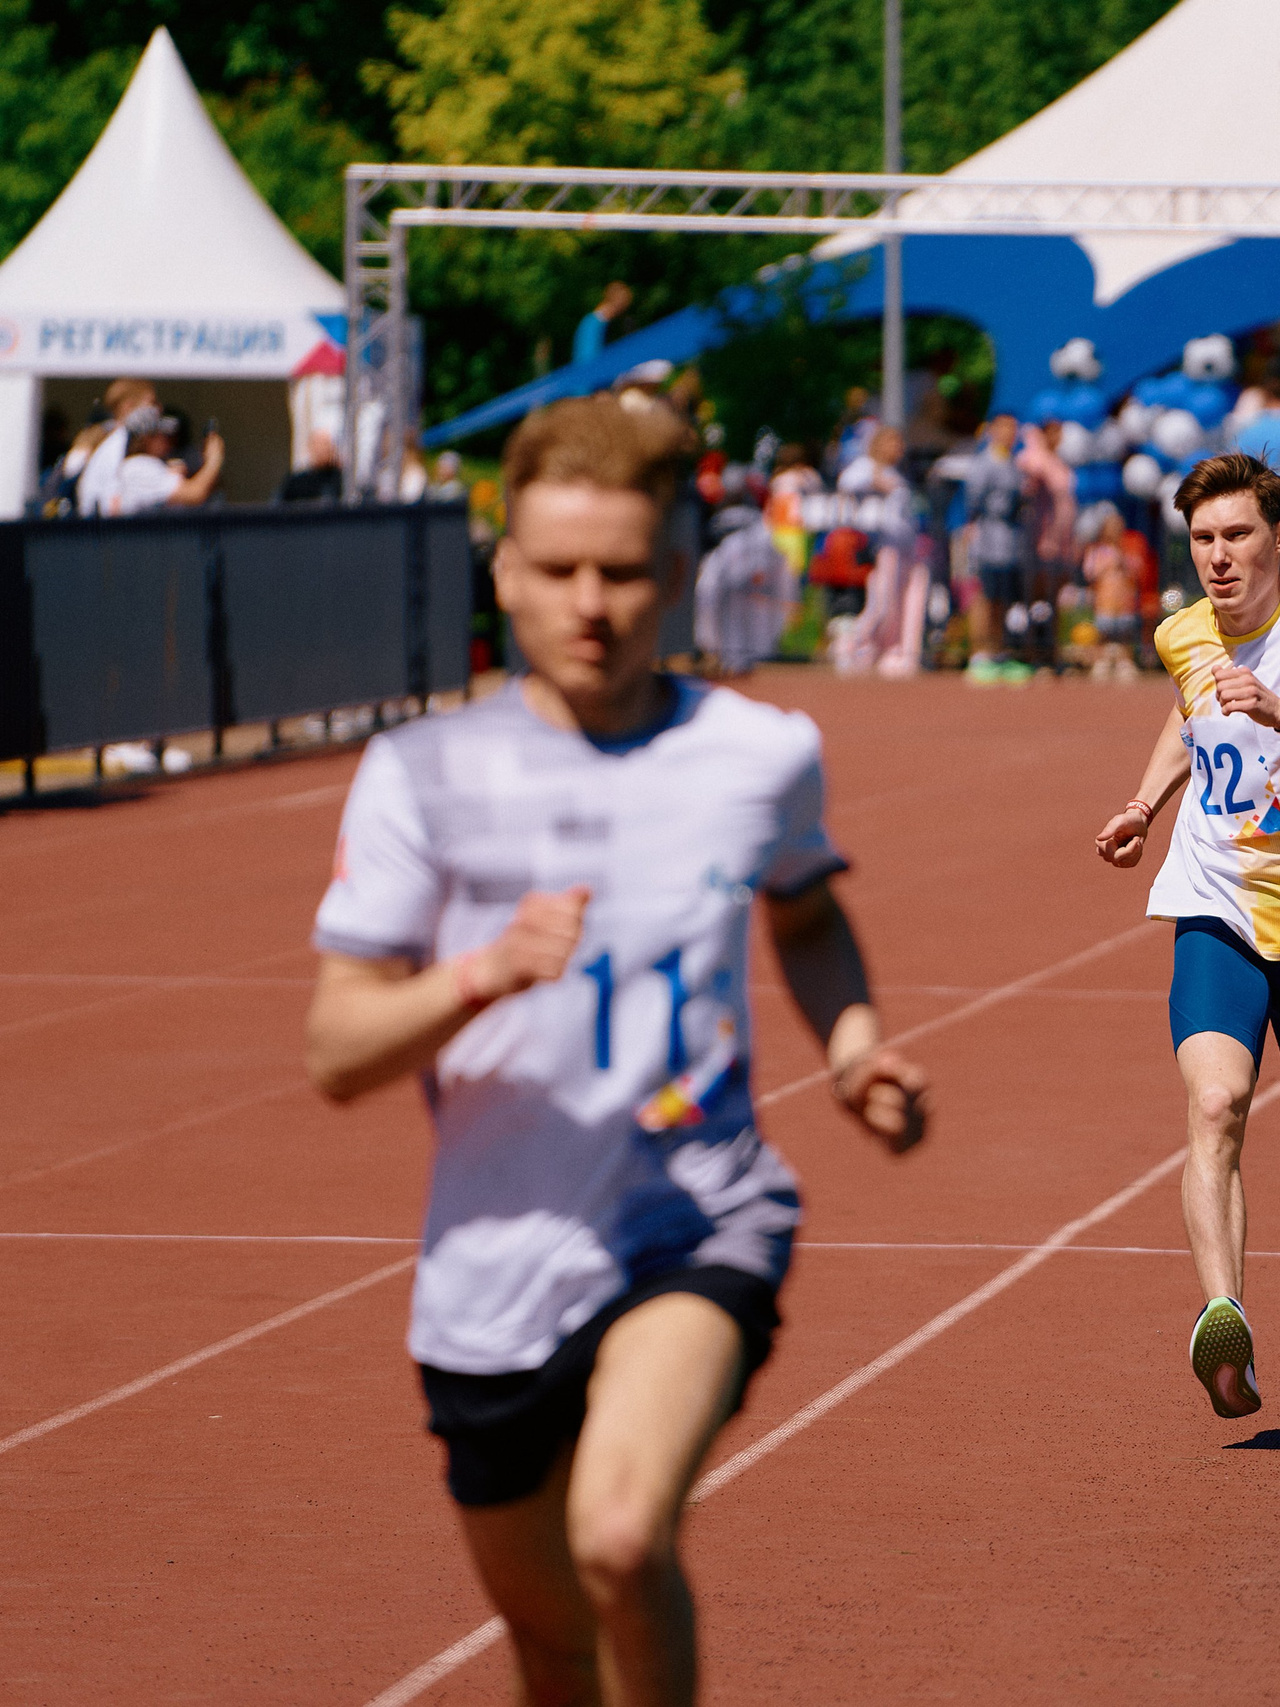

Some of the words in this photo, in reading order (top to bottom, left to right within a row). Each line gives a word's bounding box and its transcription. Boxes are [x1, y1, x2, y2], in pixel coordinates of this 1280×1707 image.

[38, 318, 286, 357] РЕГИСТРАЦИЯ
[1196, 743, 1256, 815] 22
[582, 947, 690, 1074] 11
